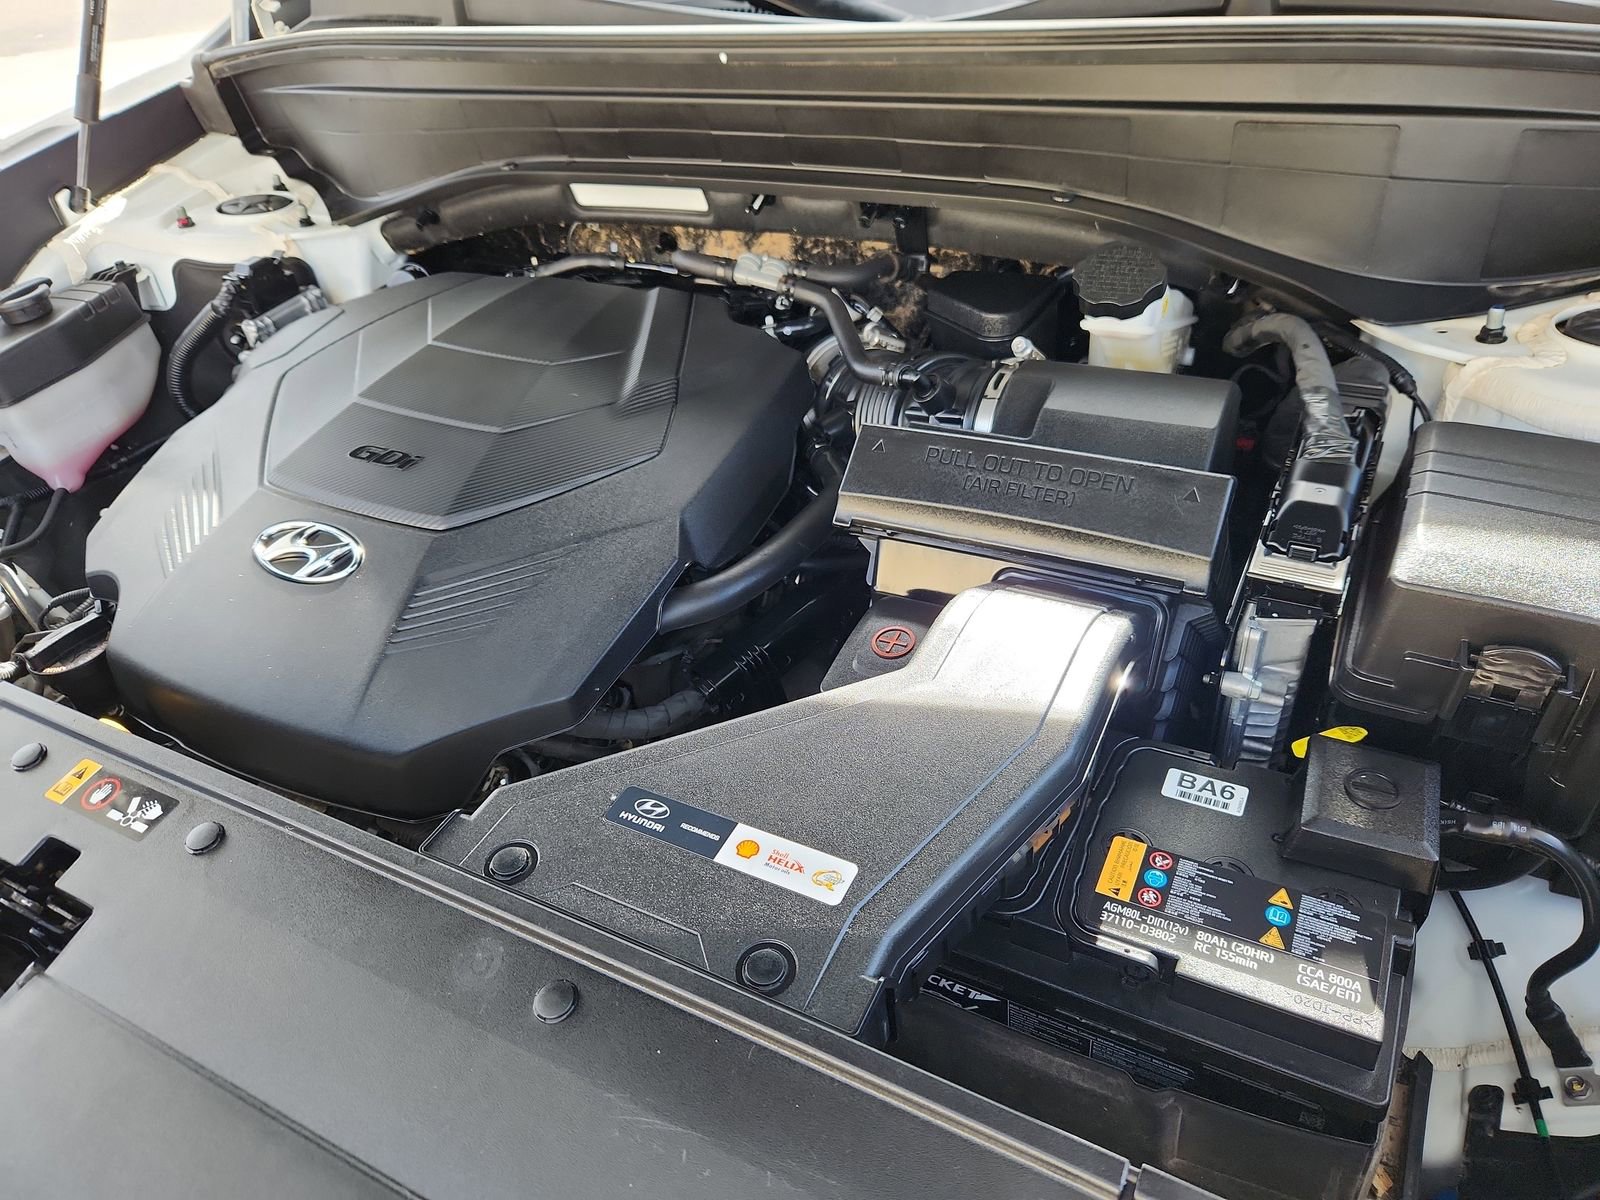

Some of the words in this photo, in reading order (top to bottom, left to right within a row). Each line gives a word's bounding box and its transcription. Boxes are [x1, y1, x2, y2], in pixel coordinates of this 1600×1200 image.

[348, 445, 425, 471] GDi
[924, 445, 976, 470] PULL
[983, 454, 1030, 476] OUT
[1034, 461, 1064, 482] TO
[1068, 467, 1135, 495] OPEN
[1177, 772, 1236, 801] BA6
[618, 810, 666, 833] HYUNDAI
[679, 822, 721, 841] RECOMMENDS
[767, 854, 805, 874] HELIX
[771, 849, 790, 859] Shell
[1100, 911, 1176, 943] 37110-D3802
[1194, 942, 1211, 955] RC
[1216, 947, 1258, 970] 155min
[1196, 931, 1228, 949] 80Ah
[1231, 941, 1275, 964] (20HR)
[1296, 975, 1361, 1003] (SAE/EN)
[1298, 963, 1325, 980] CCA
[1329, 973, 1362, 993] 800A
